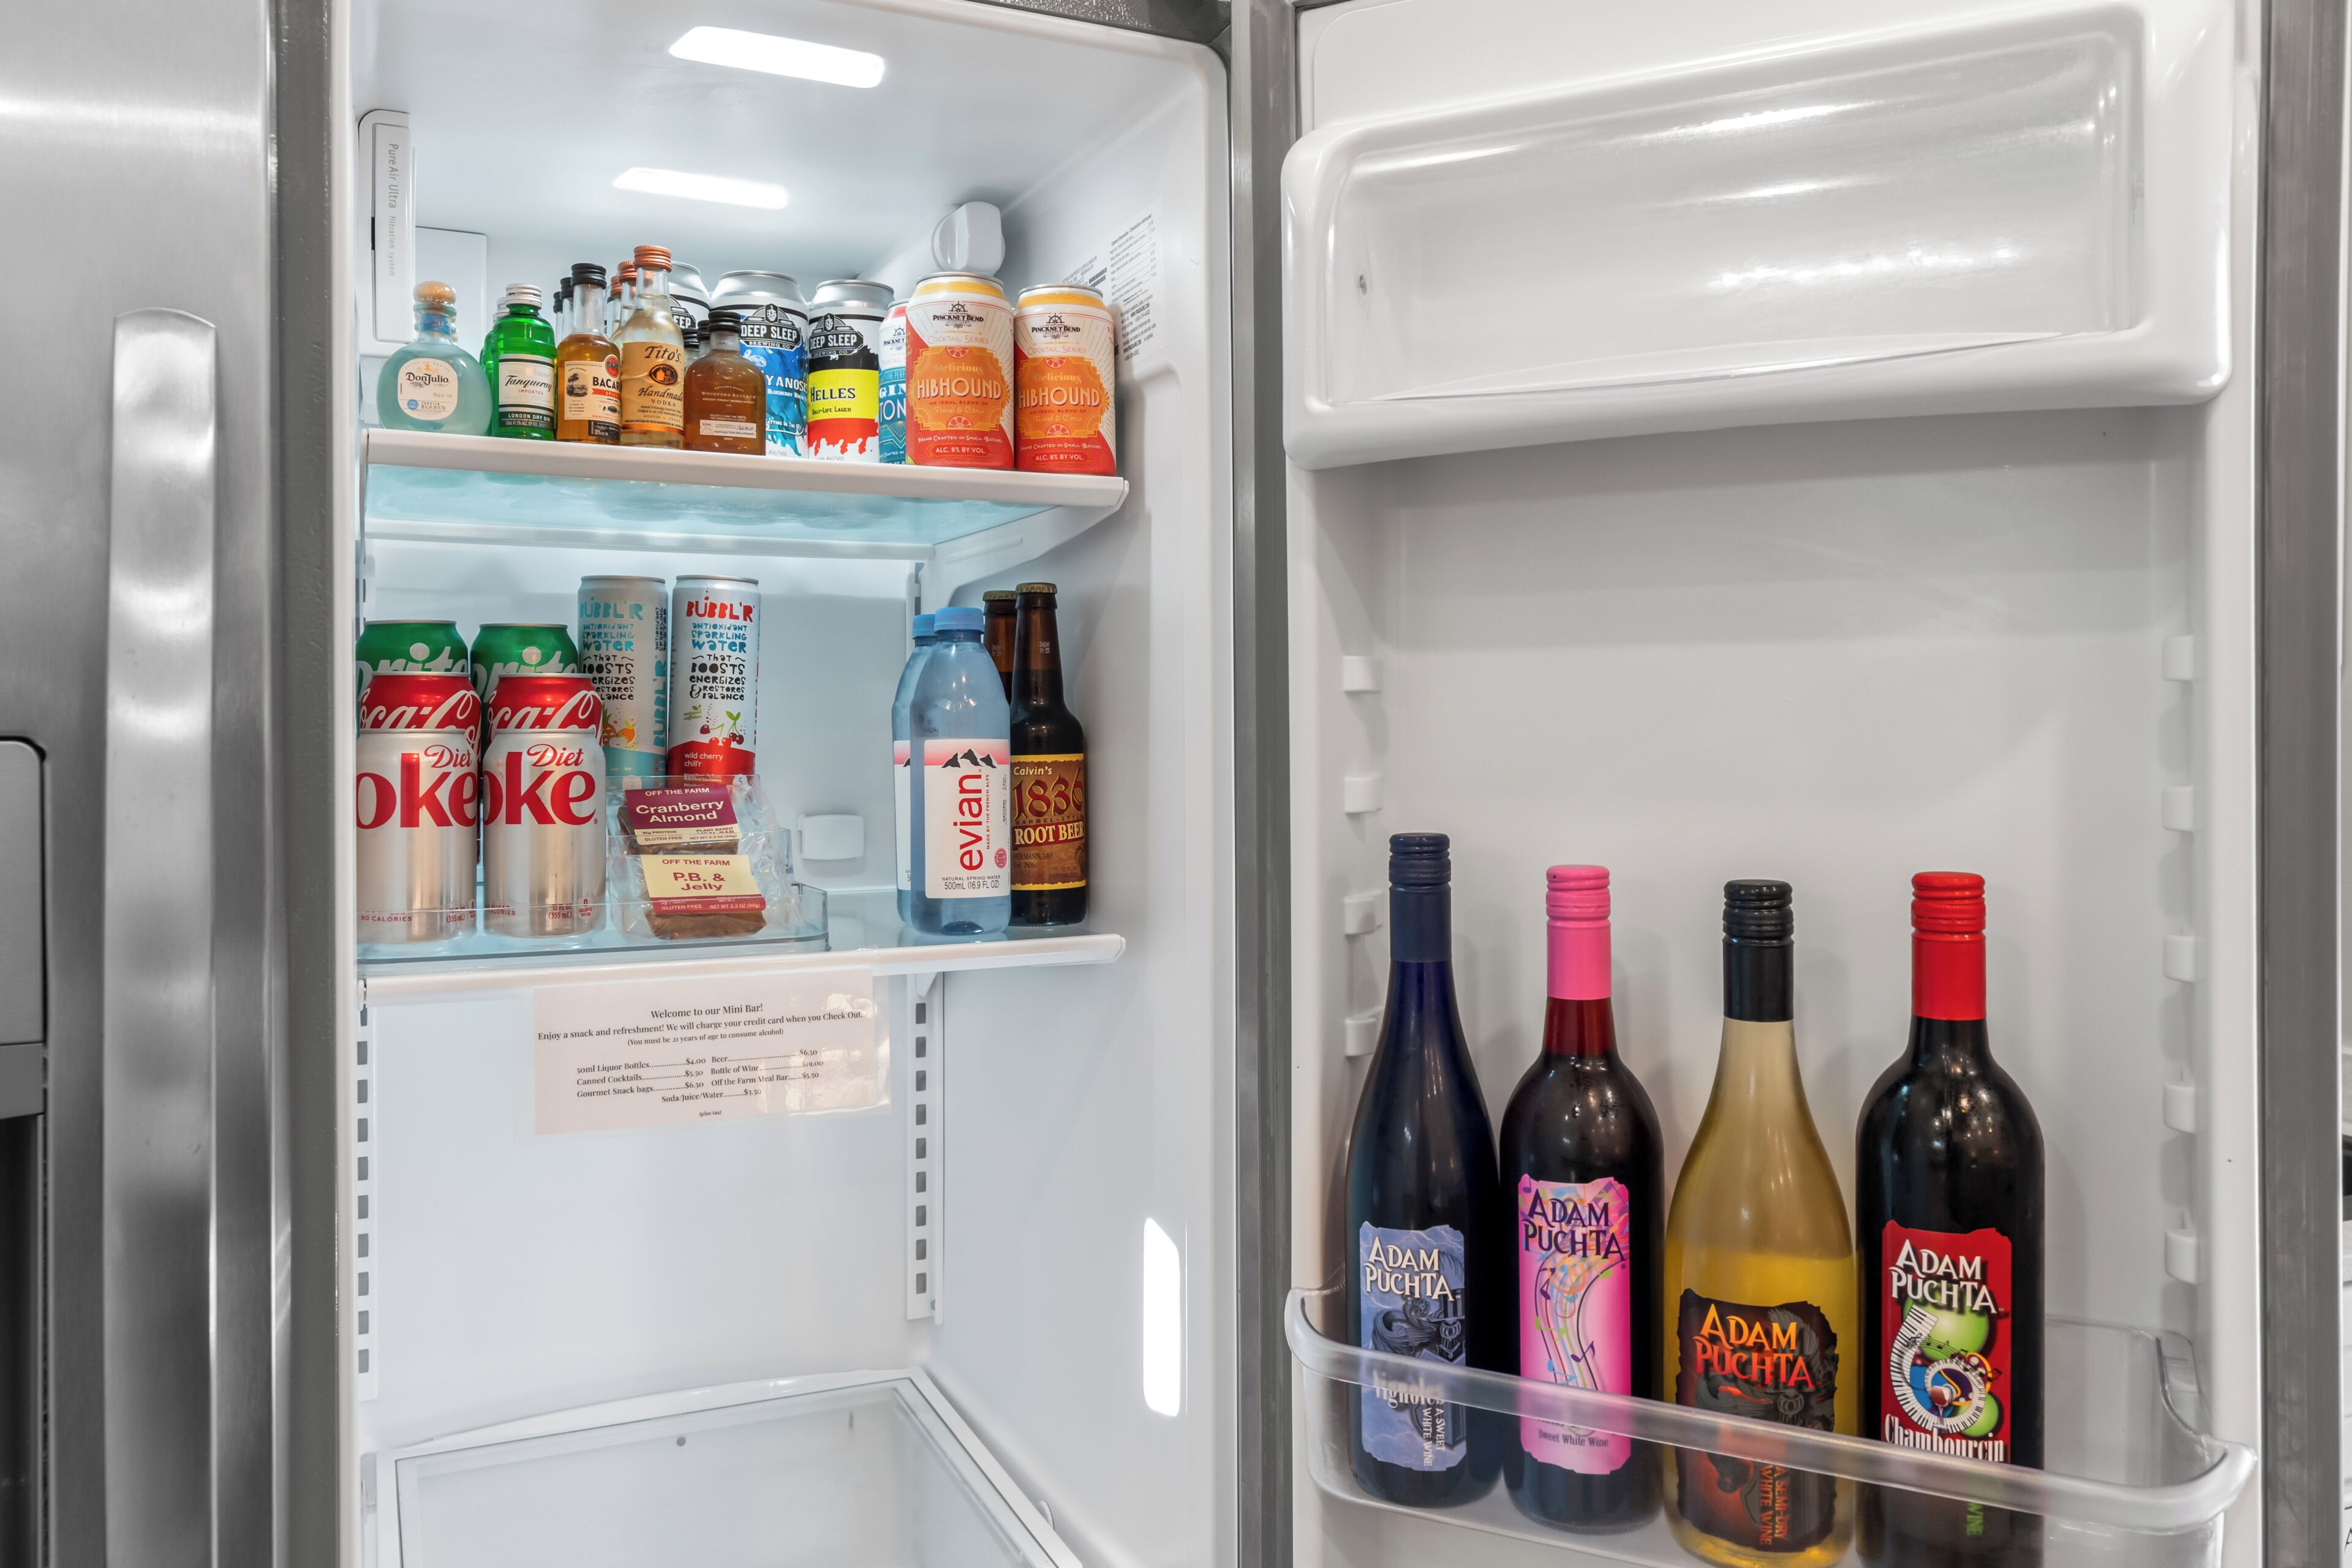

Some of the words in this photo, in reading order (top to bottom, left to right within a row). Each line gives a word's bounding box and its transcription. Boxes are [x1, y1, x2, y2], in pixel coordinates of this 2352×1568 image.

[388, 184, 399, 208] Ultra
[388, 216, 396, 249] filtration
[741, 325, 766, 337] DEEP
[771, 327, 797, 341] SLEEP
[810, 335, 825, 350] DEEP
[828, 334, 857, 347] SLEEP
[965, 335, 989, 344] SERIES
[1027, 346, 1058, 355] COCKTAIL
[505, 375, 552, 392] Tanqueray
[810, 386, 856, 402] HELLES
[918, 377, 1002, 399] HIBHOUND
[1019, 386, 1100, 409] HIBHOUND
[692, 662, 745, 675] BOOSTS
[424, 744, 472, 768] Diet
[527, 744, 584, 767] Diet
[1013, 766, 1052, 775] Calvin's
[1012, 767, 1084, 820] 1836
[636, 800, 724, 815] Cranberry
[649, 810, 718, 823] Almond
[953, 774, 983, 871] evian
[987, 823, 990, 832] BY
[1015, 814, 1084, 826] BARREL-STYLE
[1014, 825, 1056, 845] ROOT
[1058, 820, 1084, 841] BEER
[673, 872, 707, 882] P.B.
[712, 873, 726, 882] &
[944, 881, 966, 890] 500mL
[967, 881, 981, 889] (16.9
[990, 880, 1000, 889] OZ)
[651, 1009, 691, 1019] Welcome
[723, 1005, 742, 1014] Mini
[745, 1003, 763, 1012] Bar!
[538, 1032, 561, 1041] Enjoy
[570, 1029, 594, 1038] snack
[595, 1027, 611, 1036] and
[613, 1024, 664, 1035] refreshment!
[696, 1021, 723, 1030] charge
[724, 1020, 742, 1028] your
[744, 1017, 766, 1026] credit
[786, 1014, 806, 1023] when
[823, 1012, 846, 1020] Check
[759, 1028, 783, 1037] alcohol)
[577, 1065, 595, 1074] 50ml
[597, 1063, 622, 1072] Liquor
[710, 1066, 731, 1075] Bottle
[737, 1076, 756, 1085] Farm
[758, 1074, 774, 1083] Meal
[577, 1077, 606, 1085] Canned
[577, 1088, 611, 1098] Gourmet
[612, 1085, 635, 1095] Snack
[1527, 1188, 1610, 1228] ADAM
[1521, 1218, 1626, 1262] PUCHTA
[1368, 1236, 1439, 1272] ADAM
[1896, 1238, 1981, 1280] ADAM
[1363, 1261, 1455, 1302] PUCHTA
[1888, 1266, 1997, 1314] PUCHTA
[1700, 1303, 1797, 1351] ADAM
[1693, 1335, 1814, 1389] PUCHTA
[1422, 1408, 1433, 1439] WHITE
[1436, 1418, 1446, 1452] SWEET
[1539, 1429, 1559, 1443] Sweet
[1562, 1434, 1586, 1447] White
[1588, 1437, 1609, 1447] Wine
[1423, 1441, 1433, 1467] WINE
[1776, 1466, 1787, 1477] A
[1760, 1464, 1773, 1507] WHITE
[1774, 1480, 1789, 1540] SEMI-DRY
[1760, 1511, 1773, 1545] WINE
